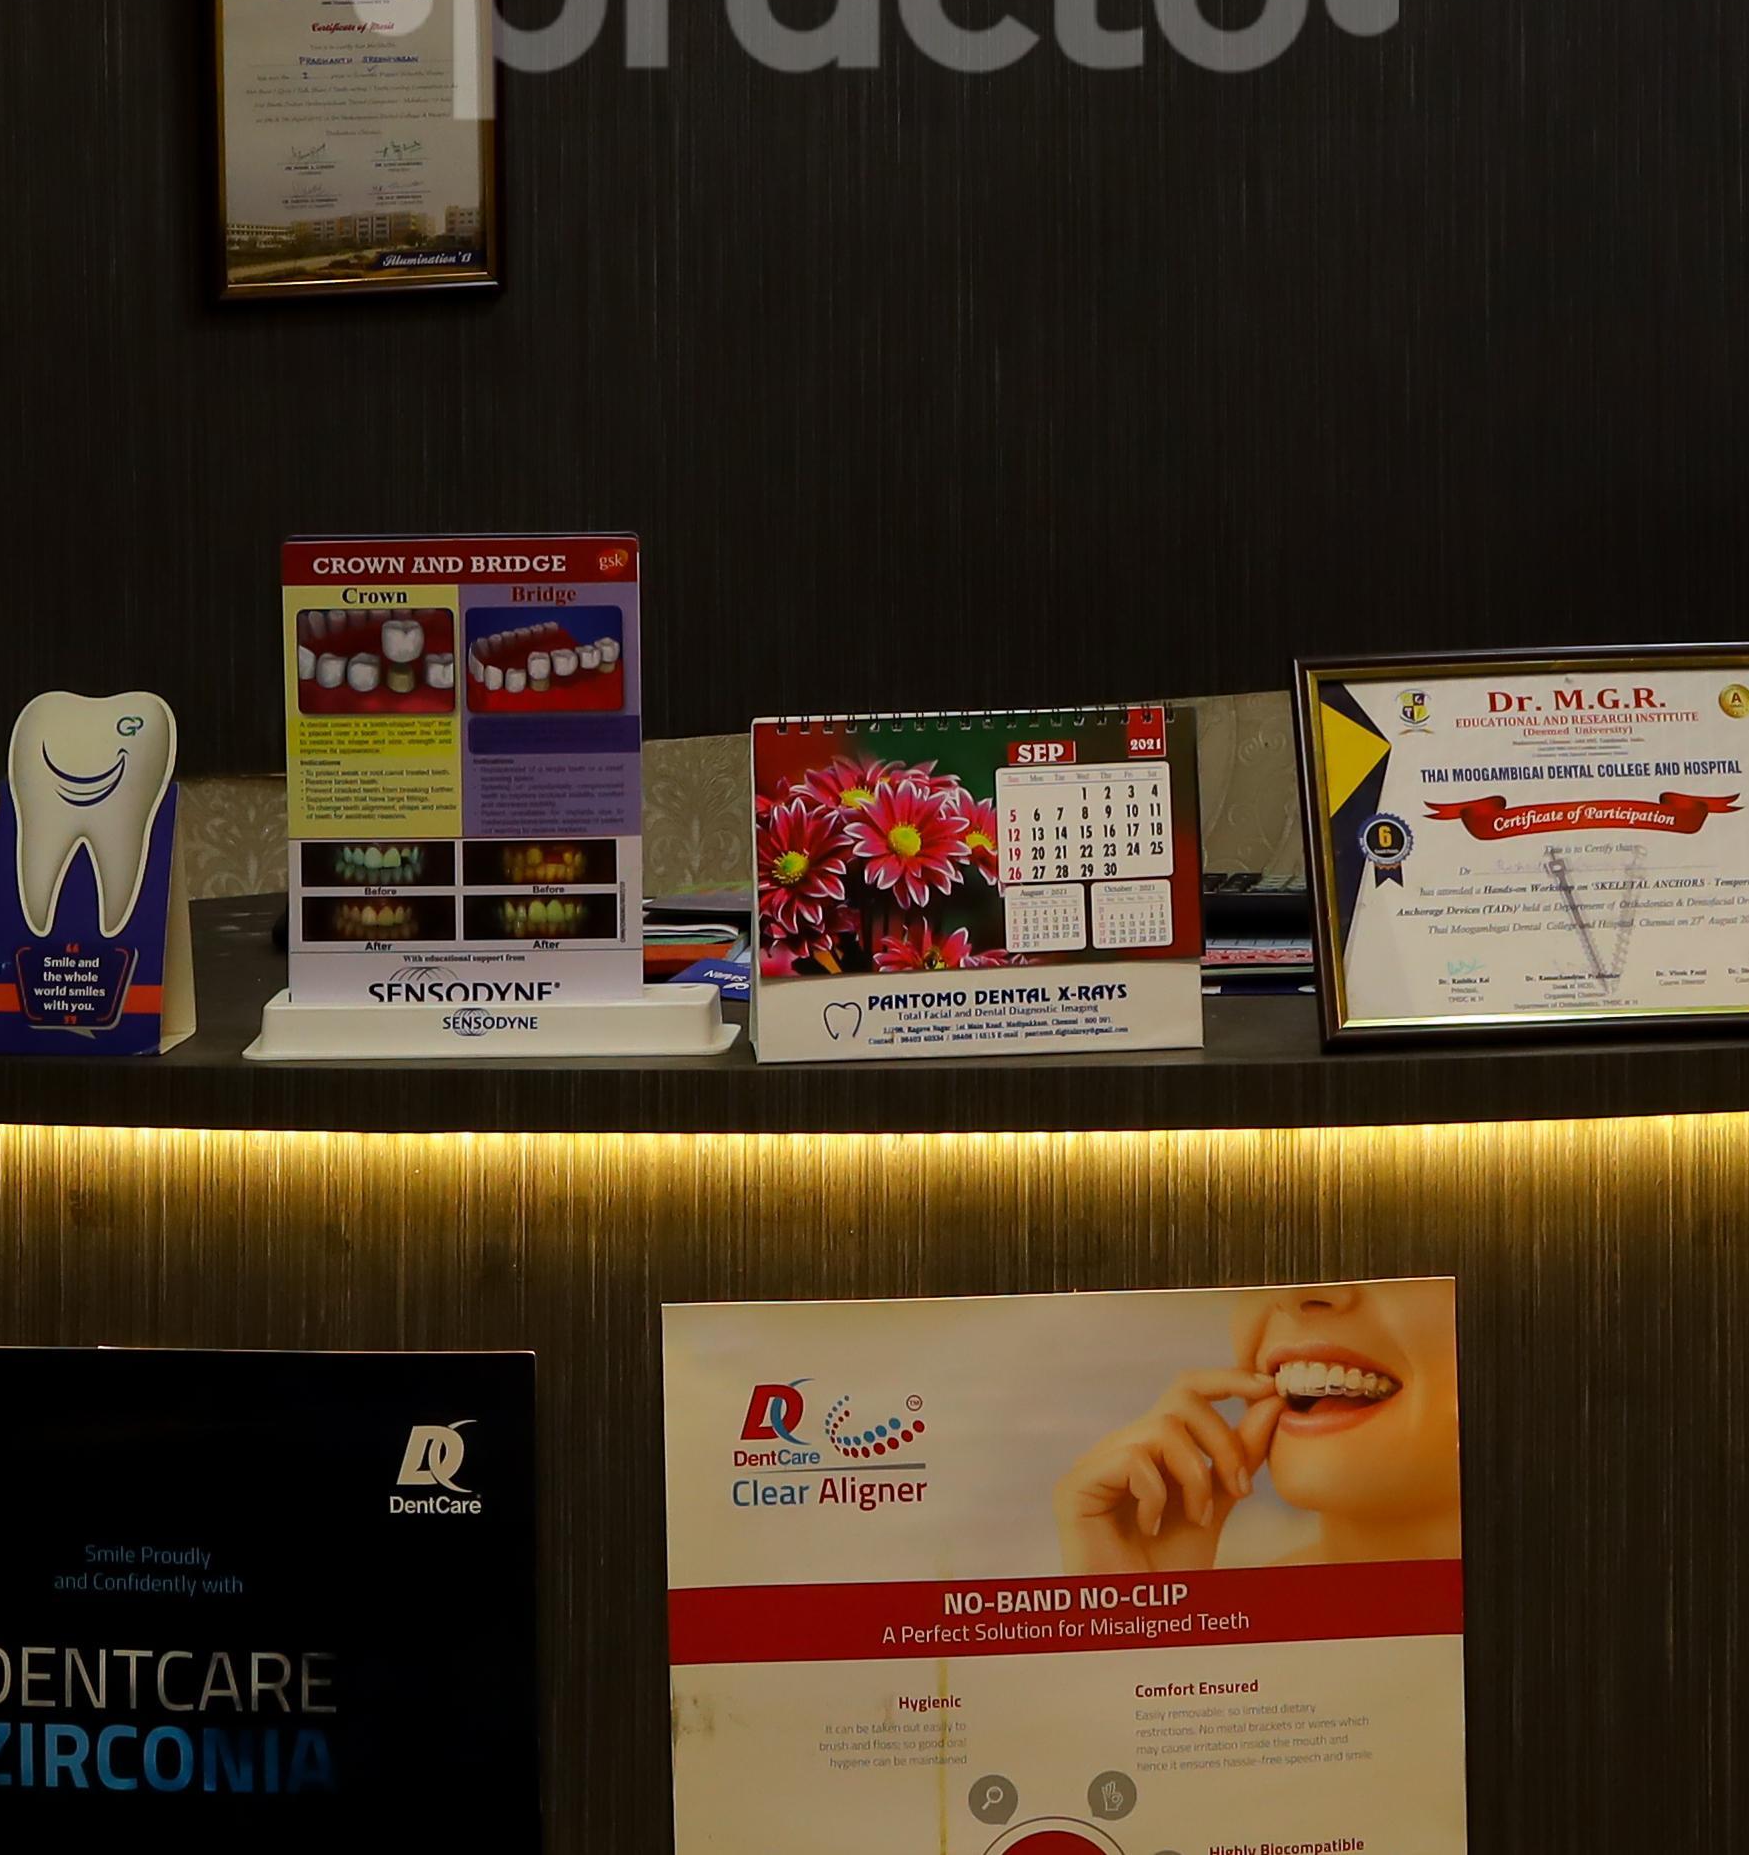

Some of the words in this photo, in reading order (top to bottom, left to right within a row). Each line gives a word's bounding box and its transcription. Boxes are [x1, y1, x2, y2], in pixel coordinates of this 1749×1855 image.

[312, 556, 405, 574] CROWN
[410, 555, 463, 574] AND
[470, 554, 567, 573] BRIDGE
[597, 552, 624, 571] gsk
[342, 587, 408, 604] Crown
[511, 586, 577, 604] Bridge
[1487, 692, 1543, 713] Dr.
[1554, 687, 1667, 711] M.G.R.
[1455, 716, 1540, 729] EDUCATIONAL
[1543, 715, 1569, 726] AND
[1571, 713, 1634, 726] RESEARCH
[1636, 711, 1699, 724] INSTITUTE
[1017, 744, 1064, 763] SEP
[1130, 738, 1161, 751] 2021
[1421, 768, 1449, 783] THAI
[1452, 766, 1545, 783] MOOGAMBIGAI
[1548, 764, 1594, 780] DENTAL
[1597, 763, 1651, 778] COLLEGE
[1654, 762, 1681, 776] AND
[1683, 760, 1743, 775] HOSPITAL
[1493, 808, 1564, 831] Certificate
[1567, 806, 1581, 823] of
[1584, 805, 1675, 826] Participation
[364, 887, 397, 896] Before
[532, 885, 565, 894] Before
[365, 942, 392, 952] After
[533, 940, 560, 949] After
[44, 956, 75, 968] Smile
[78, 956, 100, 968] and
[43, 971, 62, 982] the
[64, 972, 98, 983] whole
[33, 986, 66, 997] world
[69, 986, 106, 998] smiles
[868, 992, 967, 1011] PANTOMO
[975, 988, 1051, 1005] DENTAL
[1057, 984, 1128, 1001] X-RAYS
[43, 1000, 69, 1011] with
[71, 1001, 95, 1013] you.
[897, 1011, 922, 1021] Total
[924, 1010, 951, 1020] Facial
[954, 1009, 972, 1018] and
[974, 1007, 1006, 1017] Dental
[1008, 1004, 1058, 1017] Diagnostic
[1060, 1003, 1099, 1015] Imaging
[442, 1015, 539, 1031] SENSODYNE
[732, 1448, 821, 1468] DentCare
[731, 1477, 812, 1509] Clear
[817, 1476, 929, 1511] Aligner
[388, 1495, 482, 1516] DentCare
[83, 1544, 137, 1566] Smile
[141, 1545, 213, 1571] Proudly
[53, 1571, 89, 1592] and
[92, 1571, 197, 1598] Confidently
[201, 1574, 245, 1594] with
[943, 1589, 1073, 1616] NO-BAND
[1079, 1583, 1190, 1610] NO-CLIP
[881, 1625, 897, 1644] A
[900, 1623, 970, 1644] Perfect
[974, 1620, 1053, 1641] Solution
[1057, 1619, 1086, 1639] for
[1090, 1613, 1192, 1641] Misaligned
[1197, 1610, 1250, 1632] Teeth
[1135, 1684, 1195, 1697] Comfort
[1199, 1680, 1259, 1695] Ensured
[898, 1695, 962, 1713] Hygienic
[1261, 1839, 1364, 1855] Biocompatible
